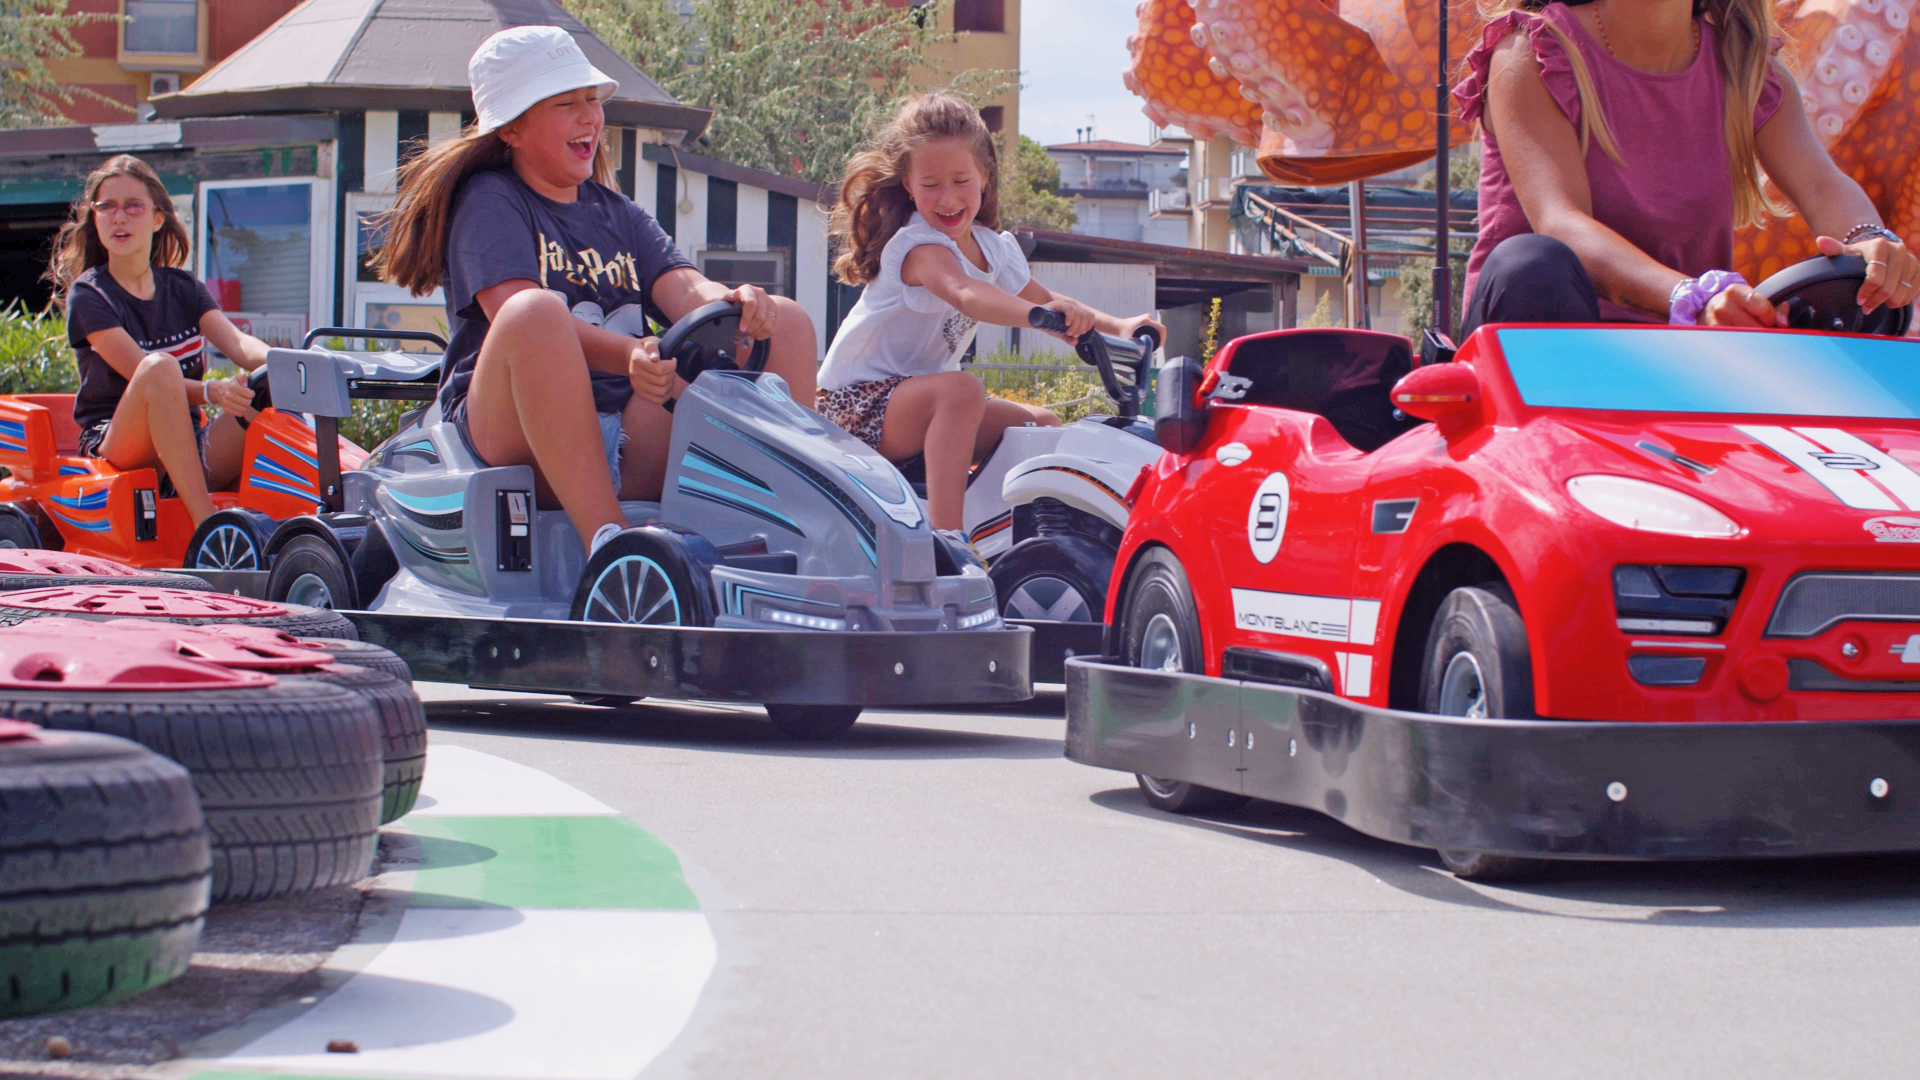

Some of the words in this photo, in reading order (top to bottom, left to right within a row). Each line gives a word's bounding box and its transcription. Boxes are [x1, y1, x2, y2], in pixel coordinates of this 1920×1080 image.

[547, 45, 578, 60] LOVE
[296, 361, 307, 395] 1
[1238, 612, 1320, 635] MONTBLANC
